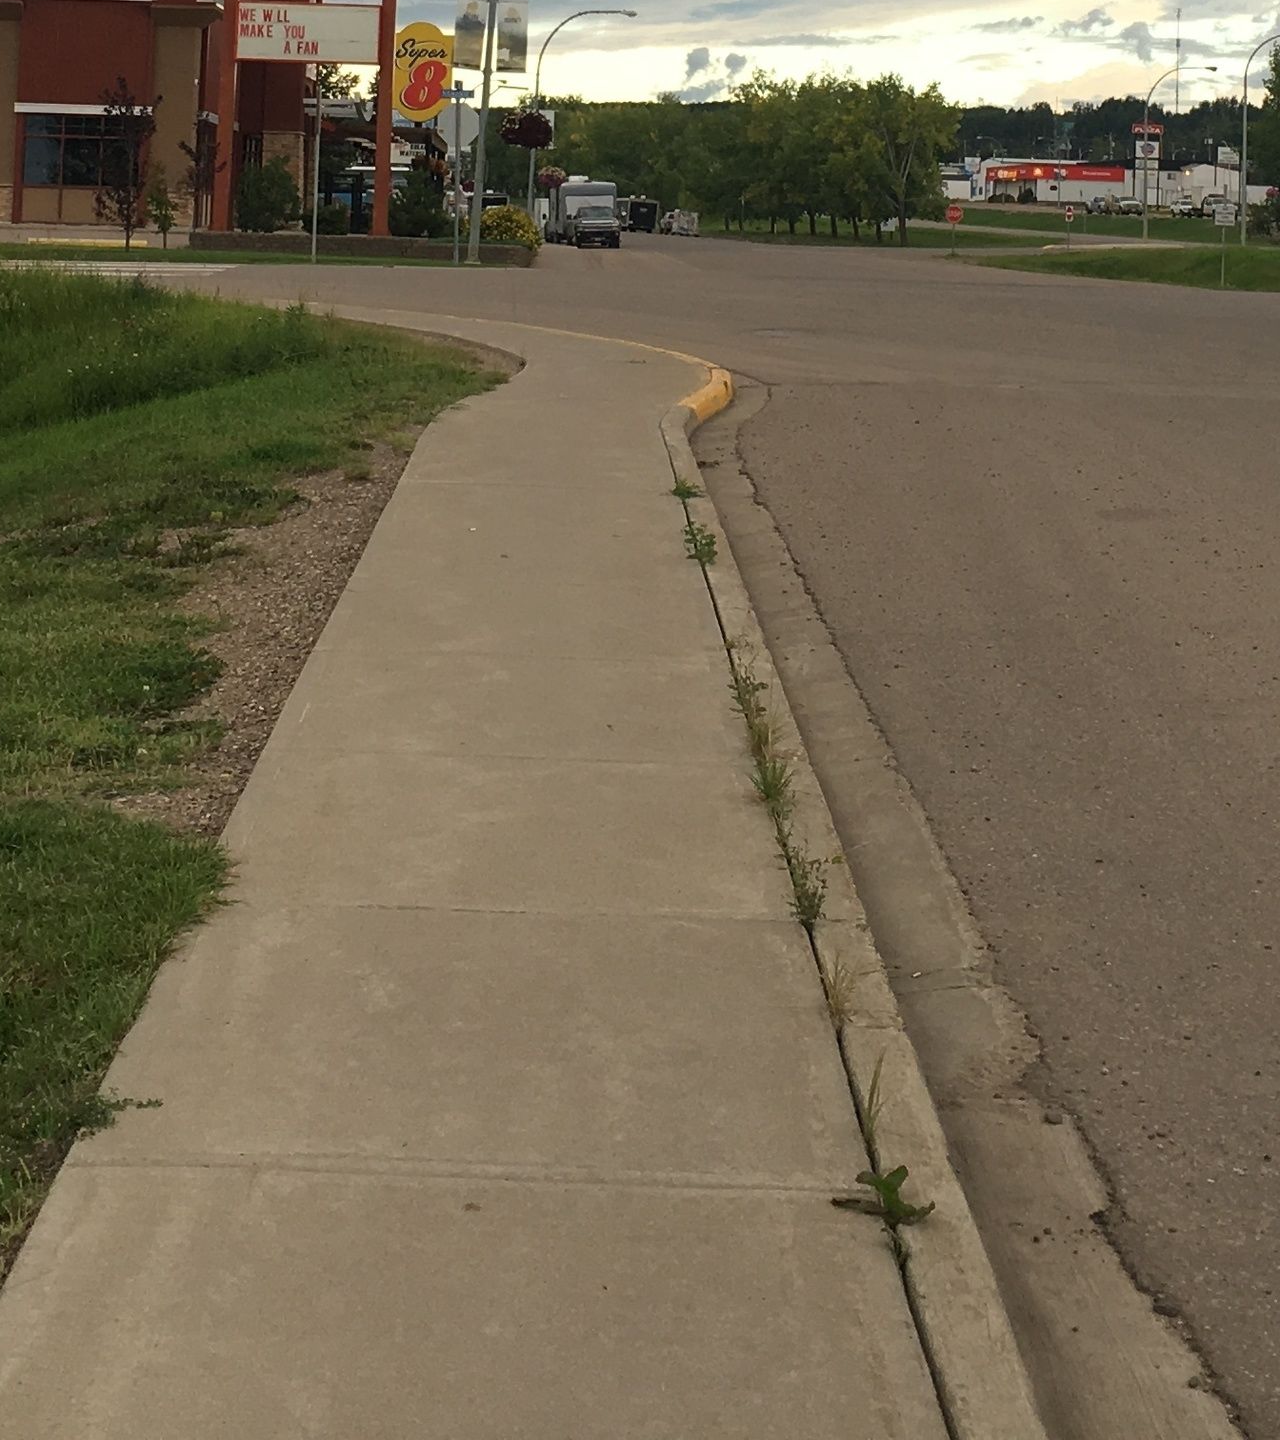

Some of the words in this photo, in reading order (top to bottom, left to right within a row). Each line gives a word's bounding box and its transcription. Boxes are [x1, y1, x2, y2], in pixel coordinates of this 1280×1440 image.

[240, 8, 256, 21] WE
[240, 24, 273, 38] MAKE
[284, 25, 305, 39] YOU
[283, 41, 291, 54] A
[297, 41, 319, 55] FAN
[396, 38, 448, 68] Super
[400, 60, 448, 111] 8
[1134, 126, 1161, 134] PLZA
